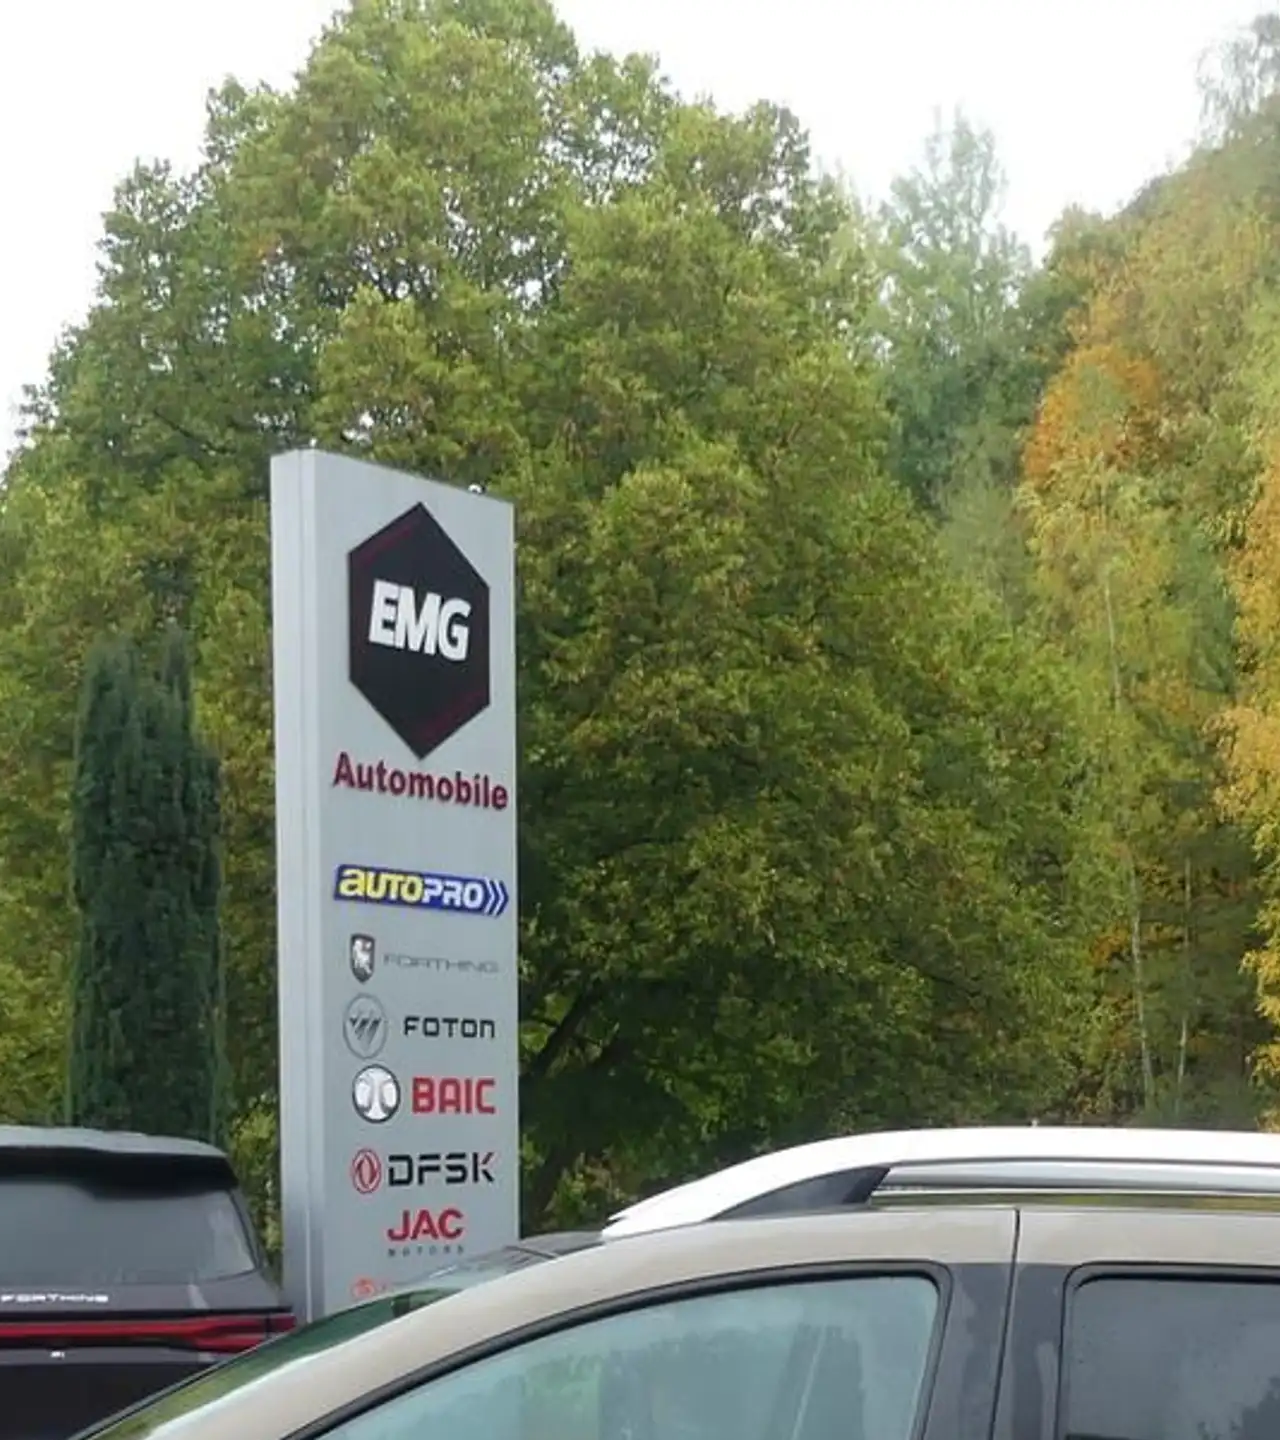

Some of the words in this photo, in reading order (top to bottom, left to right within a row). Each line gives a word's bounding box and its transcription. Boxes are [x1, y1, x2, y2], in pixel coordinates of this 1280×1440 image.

[369, 579, 471, 662] EMG
[333, 751, 509, 811] Automobile
[404, 1016, 496, 1038] FOTON
[412, 1077, 496, 1115] BAIC
[388, 1152, 495, 1186] DFSK
[387, 1209, 464, 1240] JAC
